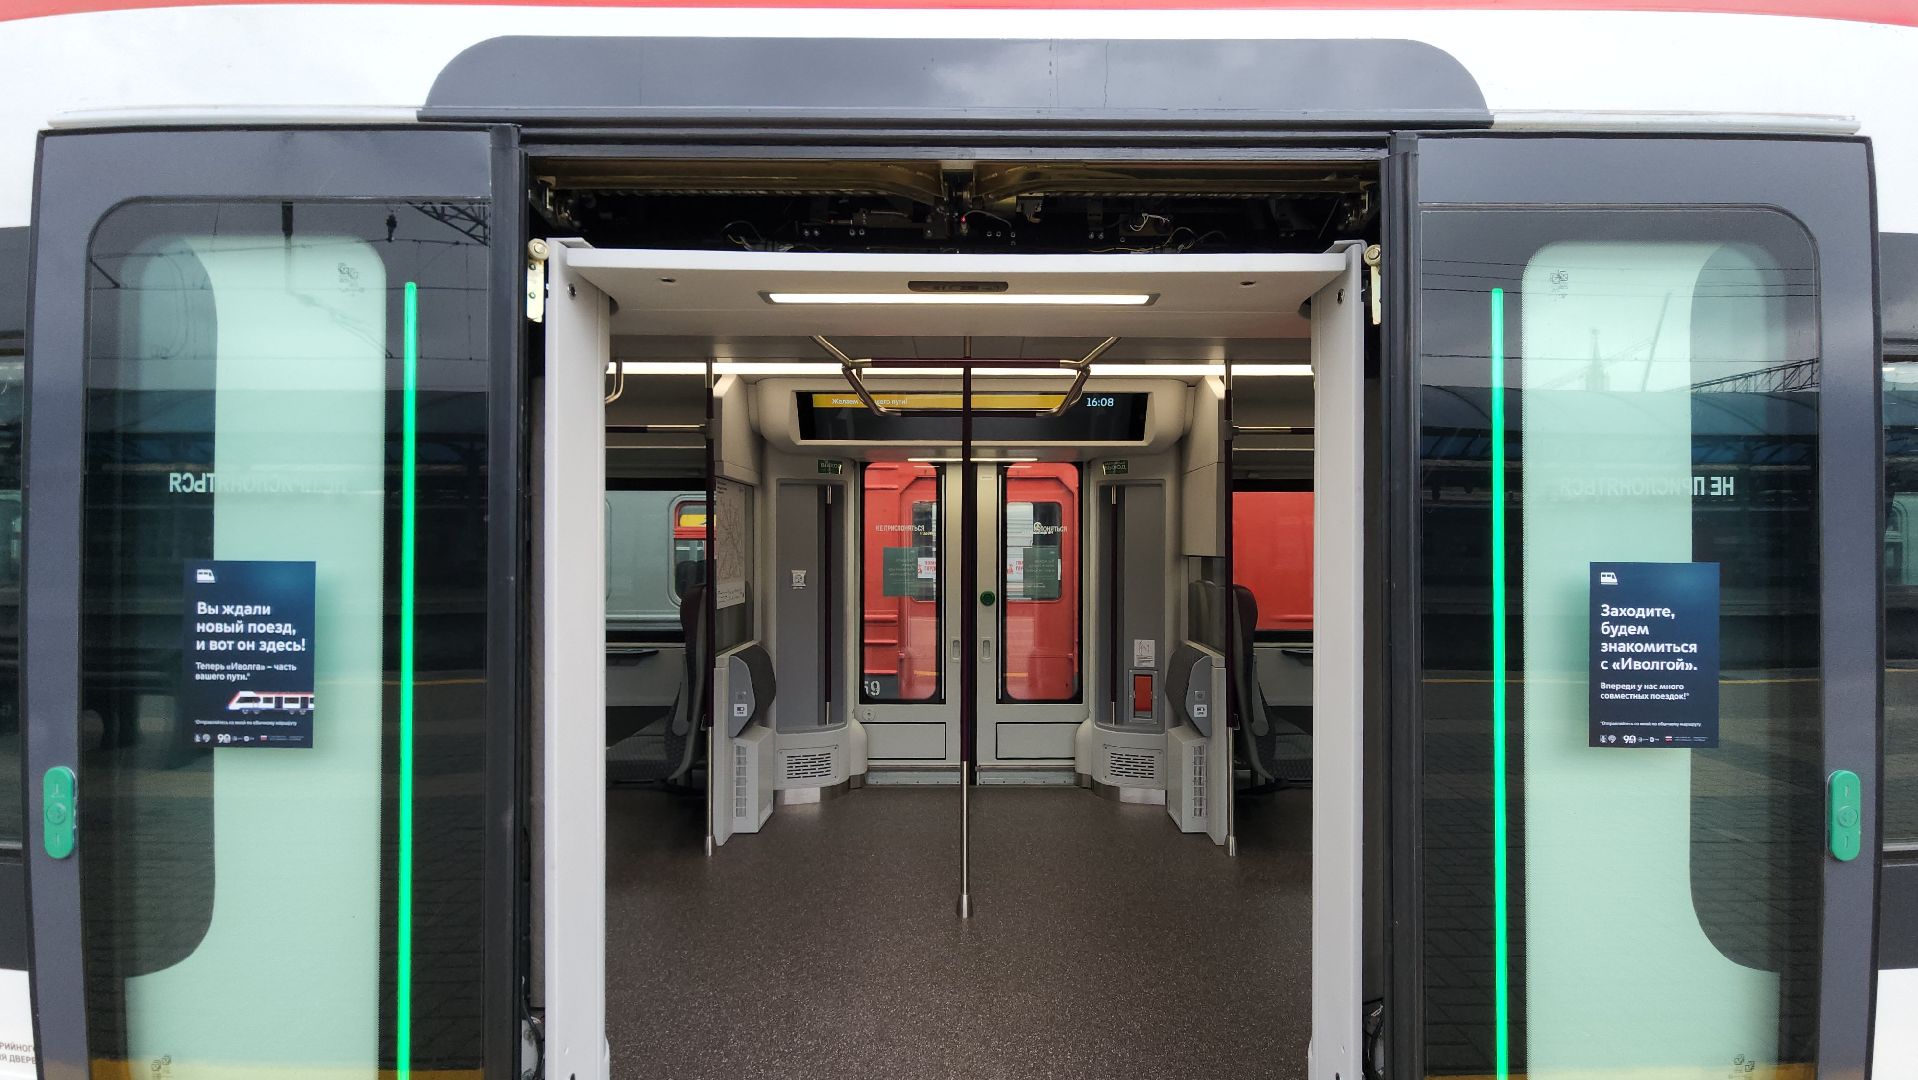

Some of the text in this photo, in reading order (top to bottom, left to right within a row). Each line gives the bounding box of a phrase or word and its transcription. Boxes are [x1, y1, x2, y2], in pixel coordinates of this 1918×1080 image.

[1086, 397, 1114, 407] 16:08
[197, 601, 271, 617] Вы ждали
[1600, 604, 1675, 619] Заходите,
[196, 620, 296, 636] новый поезд,
[1601, 621, 1649, 637] будем
[196, 638, 306, 653] и вот он здесь!
[1600, 642, 1698, 653] знакомиться
[195, 661, 225, 671] Теперь
[1600, 657, 1698, 671] с «Иволгой».
[195, 673, 225, 681] вашего
[1600, 682, 1636, 691] Впереди
